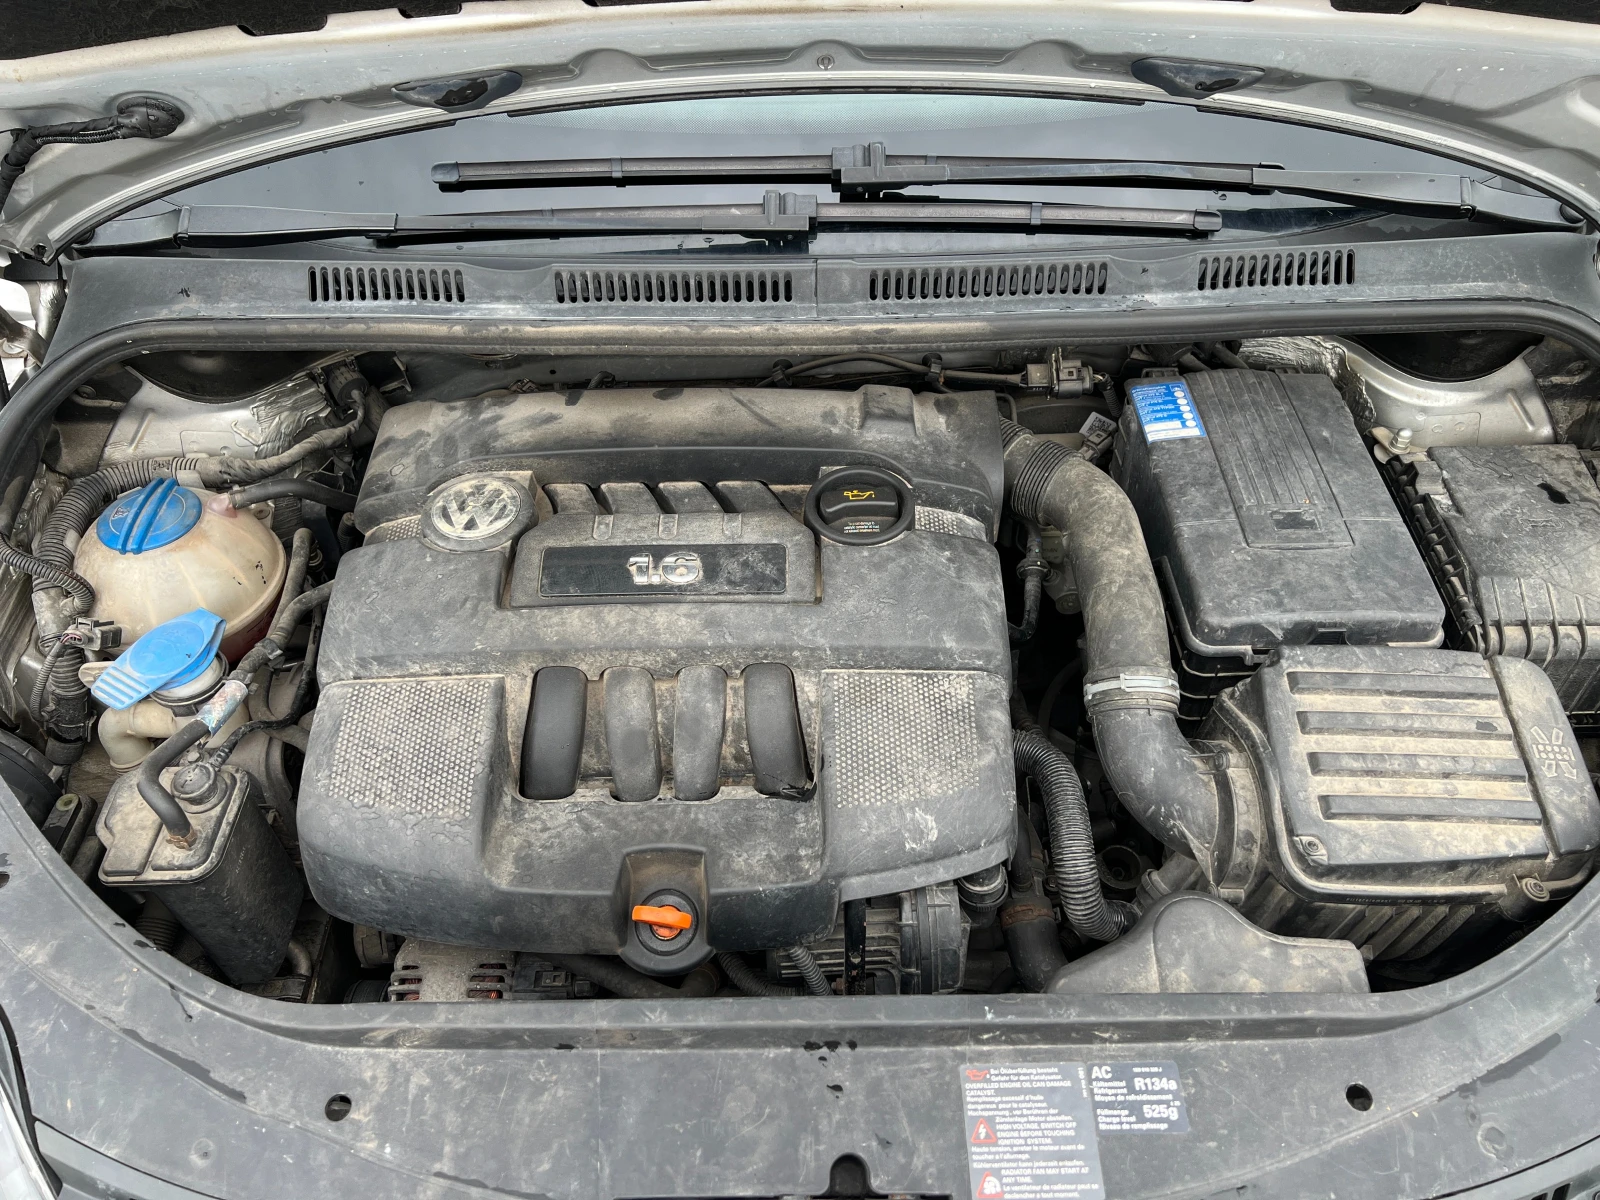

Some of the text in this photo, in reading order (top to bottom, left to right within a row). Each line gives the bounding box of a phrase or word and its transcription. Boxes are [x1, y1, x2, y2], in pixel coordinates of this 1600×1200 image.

[432, 477, 520, 540] VW
[628, 552, 700, 585] 1.6
[1092, 1066, 1112, 1079] AC
[1134, 1077, 1178, 1090] R134a
[1143, 1104, 1178, 1120] 525g
